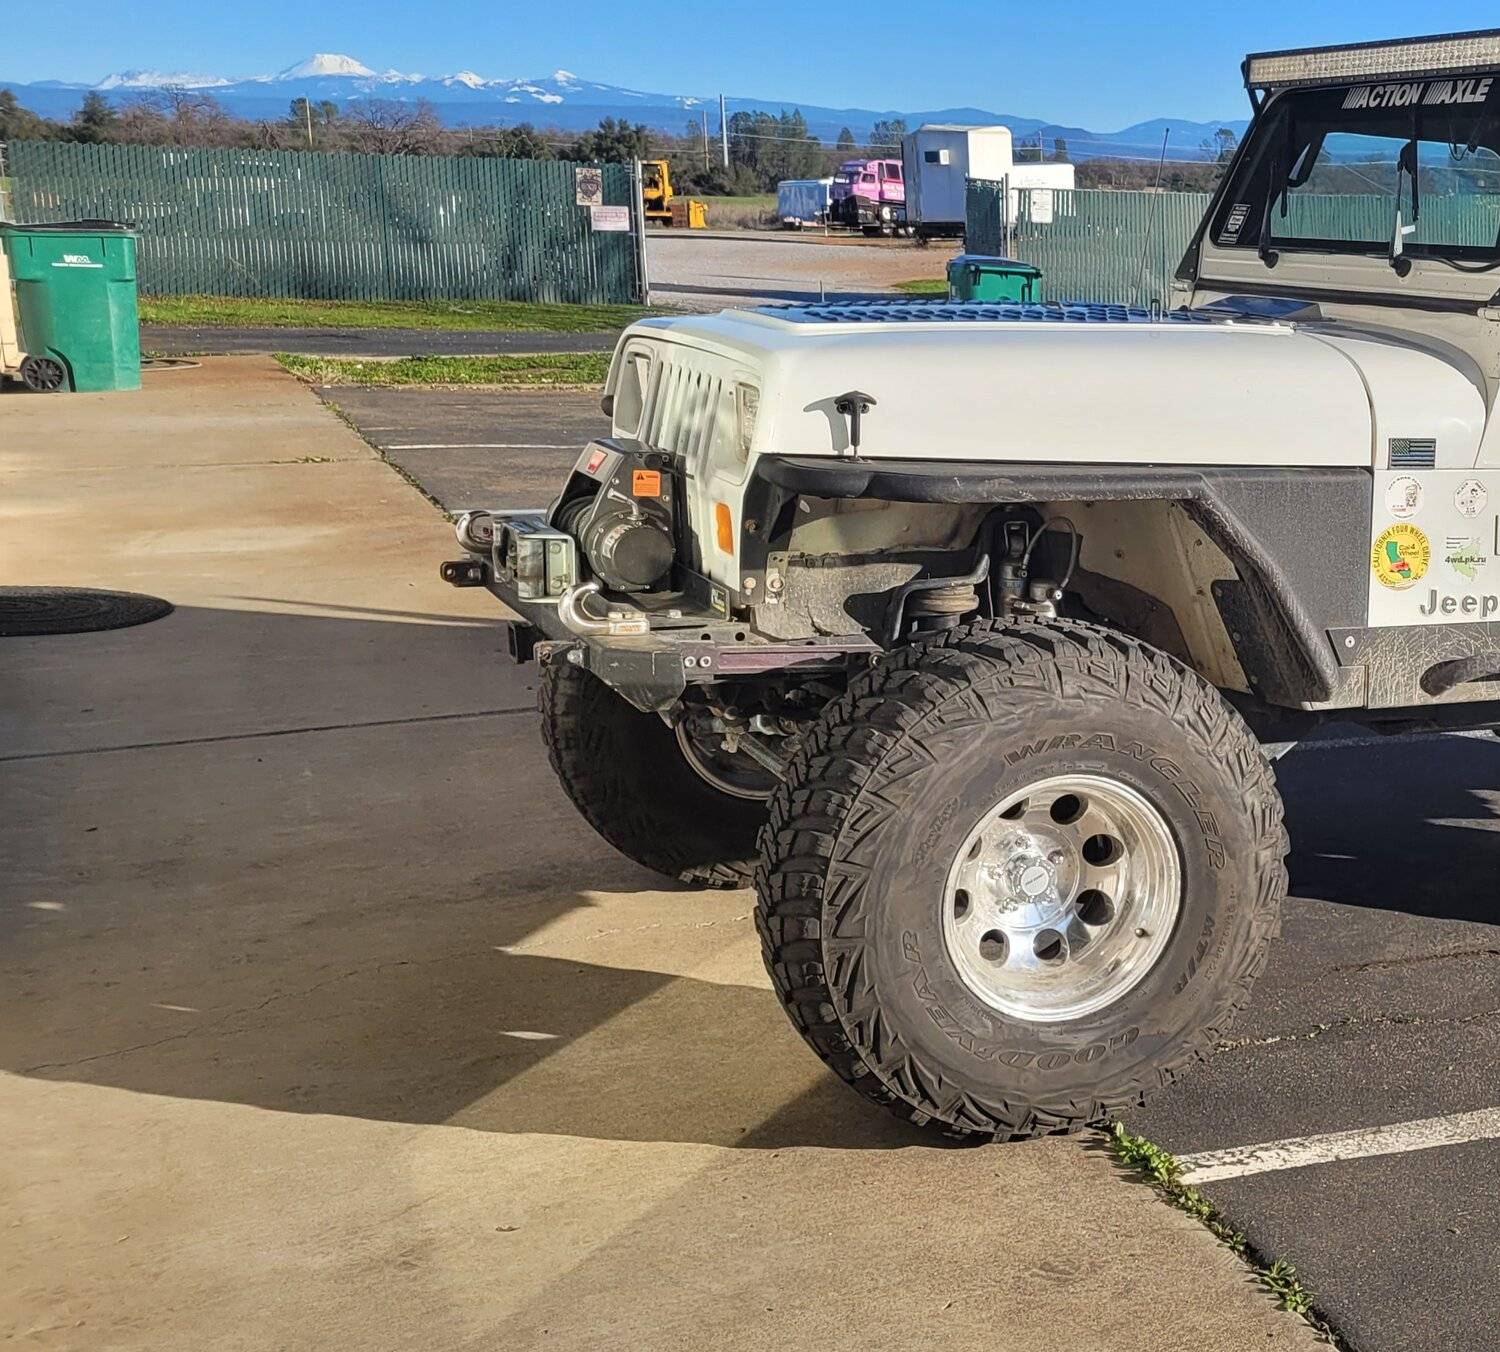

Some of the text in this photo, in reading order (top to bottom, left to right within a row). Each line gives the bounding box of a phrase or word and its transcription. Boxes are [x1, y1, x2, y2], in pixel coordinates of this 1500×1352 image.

[1348, 78, 1493, 109] ACTION AXLE
[1373, 530, 1392, 568] CALIFORNIA
[1392, 525, 1409, 535] FOUR
[1409, 527, 1426, 545] WHEEL
[1445, 556, 1487, 565] 4wd.pk.ru
[1419, 589, 1498, 617] Jeep
[1003, 733, 1226, 870] WRANGLER
[902, 930, 1140, 1071] GOODYEAR
